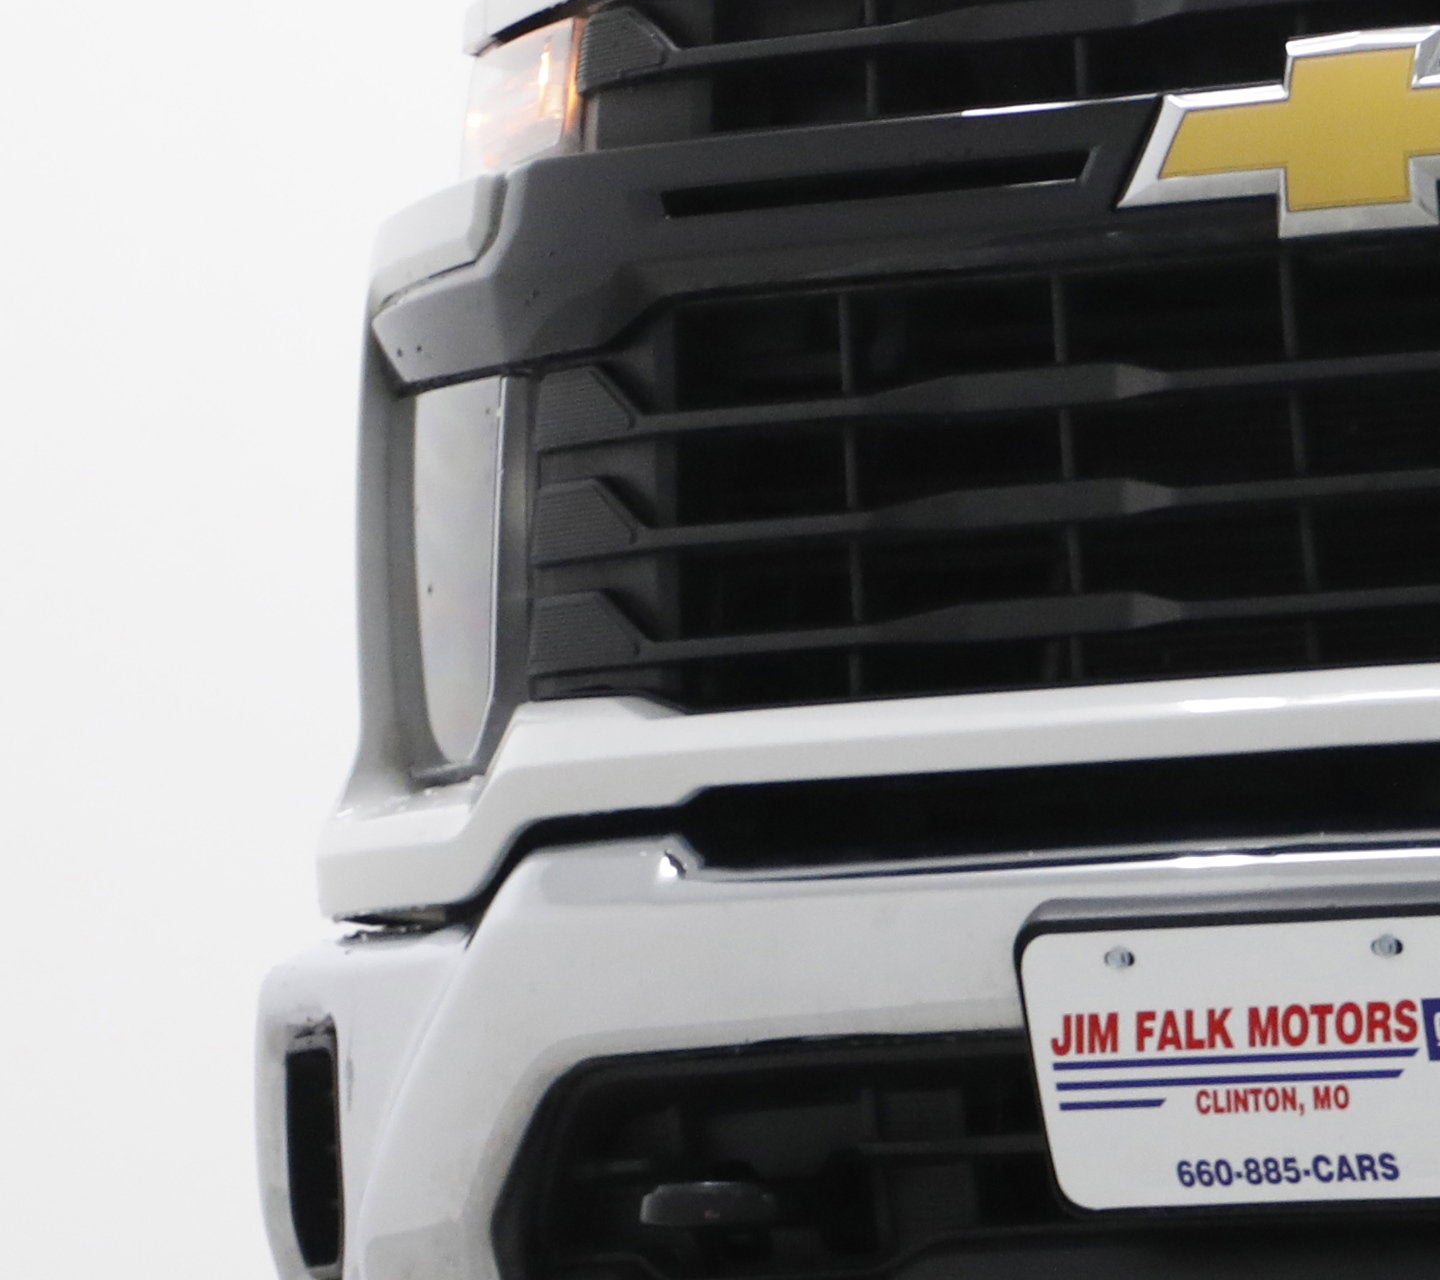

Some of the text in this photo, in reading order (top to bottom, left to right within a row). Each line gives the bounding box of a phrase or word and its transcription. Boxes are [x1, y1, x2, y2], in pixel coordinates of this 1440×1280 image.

[1051, 999, 1419, 1056] JIM FALK MOTORS
[1195, 1084, 1350, 1116] CLINTON, MO
[1176, 1152, 1400, 1187] 660-885-CARS
